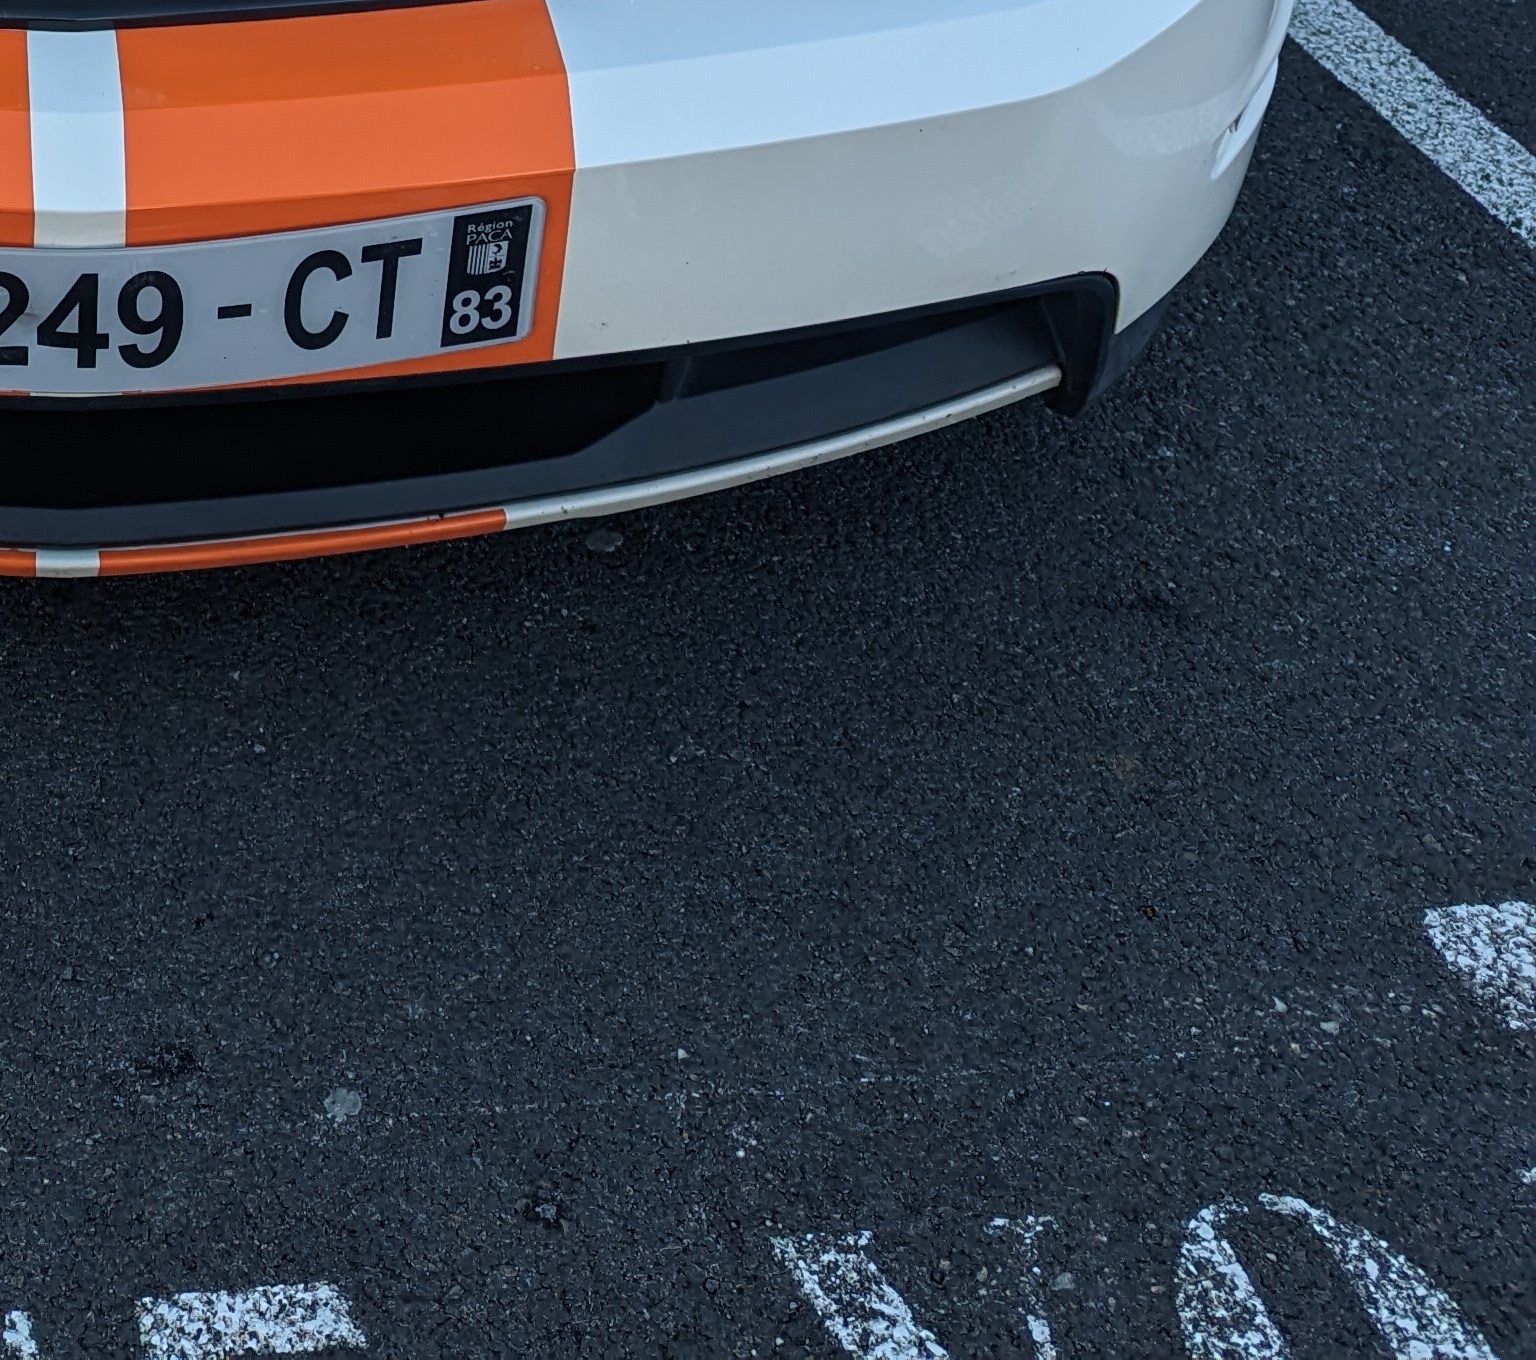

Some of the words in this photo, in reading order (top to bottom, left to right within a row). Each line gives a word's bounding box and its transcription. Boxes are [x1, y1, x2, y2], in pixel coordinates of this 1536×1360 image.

[467, 220, 513, 234] Région
[466, 229, 513, 245] PACA
[449, 284, 513, 335] 83
